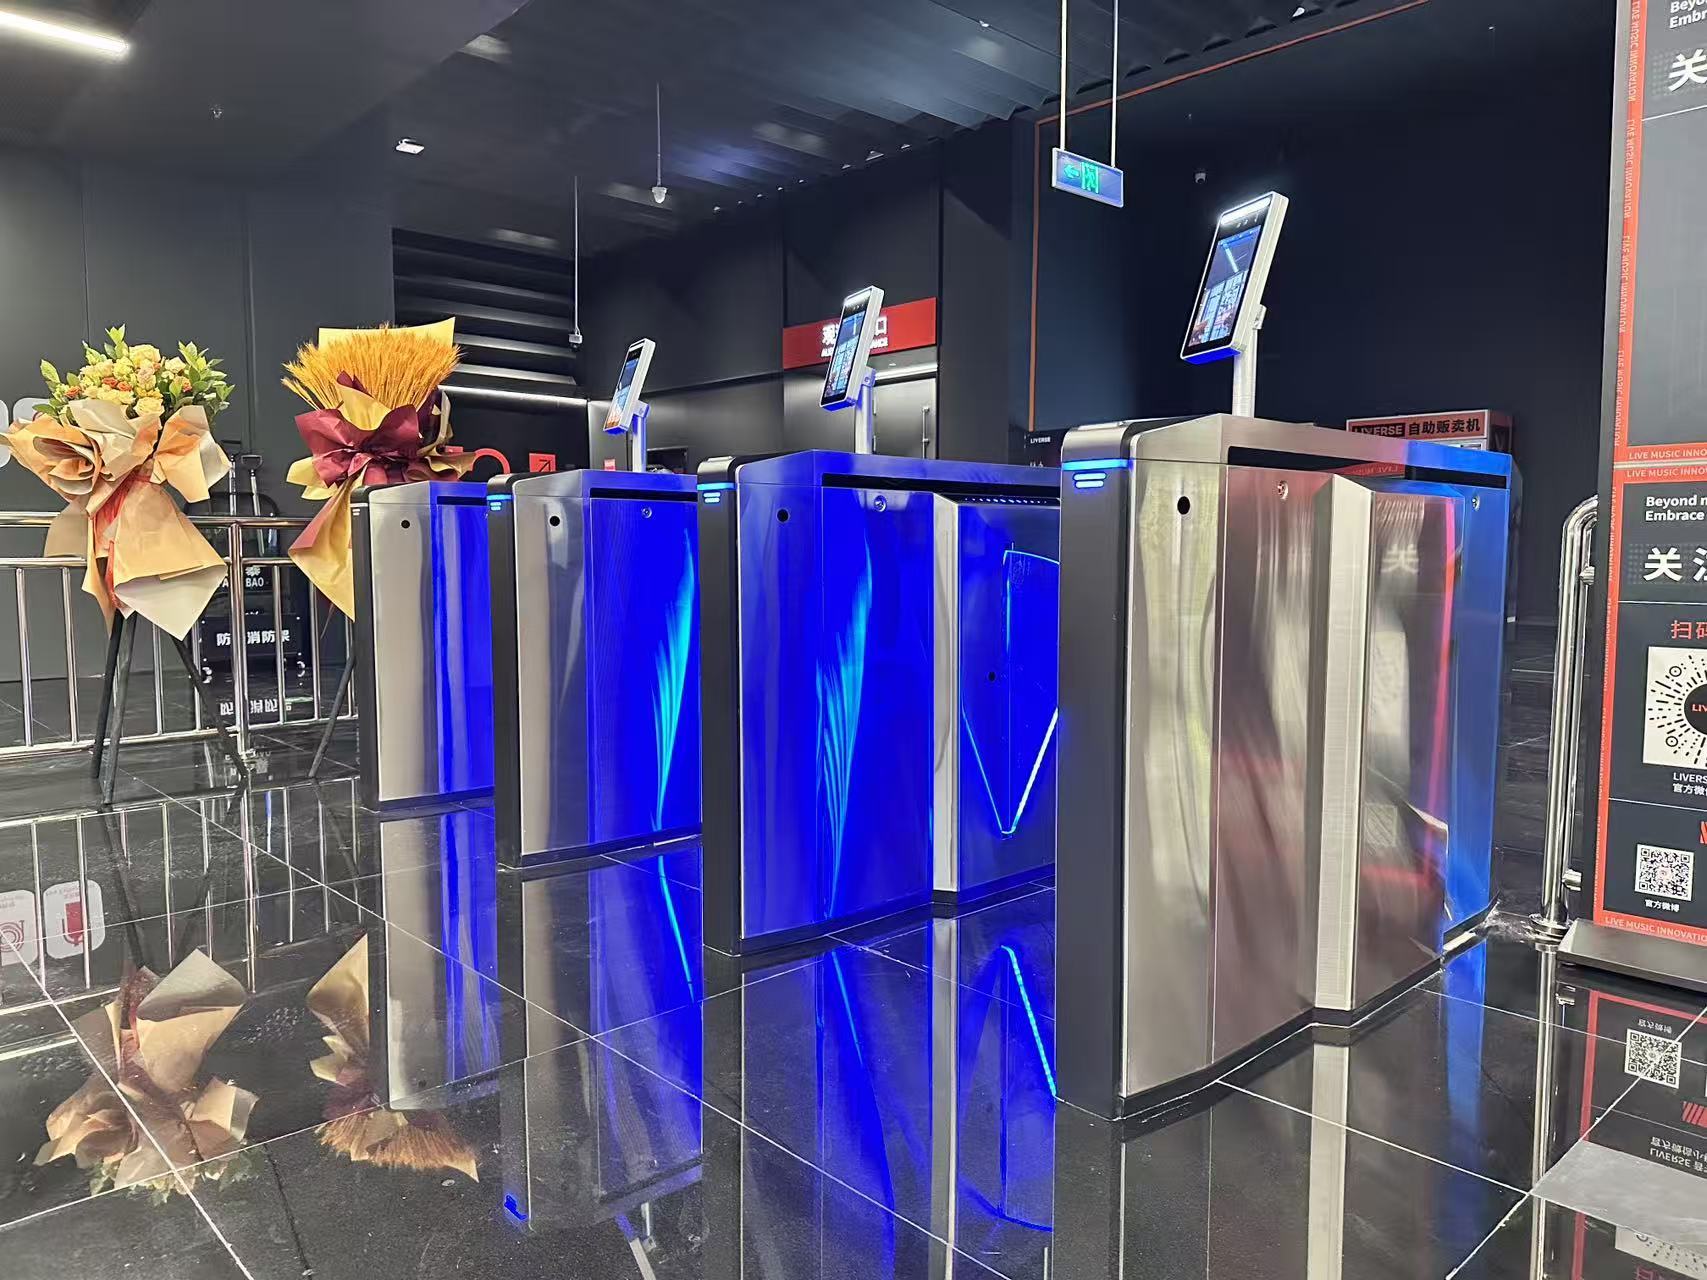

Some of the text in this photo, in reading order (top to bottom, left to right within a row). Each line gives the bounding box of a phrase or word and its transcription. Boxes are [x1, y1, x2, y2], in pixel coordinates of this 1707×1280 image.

[1408, 418, 1480, 436] 自助贩卖机
[1629, 452, 1648, 460] LIVE
[1650, 449, 1680, 459] MUSIC
[1627, 467, 1707, 478] LIVE MUSIC INNO
[1646, 494, 1698, 509] Beyond
[1645, 509, 1705, 521] Embrace
[245, 577, 264, 587] BAO
[1672, 783, 1707, 797] 官方微
[1644, 899, 1680, 913] 官方微博
[1605, 916, 1625, 927] LIVE
[1626, 920, 1655, 932] MUSIC
